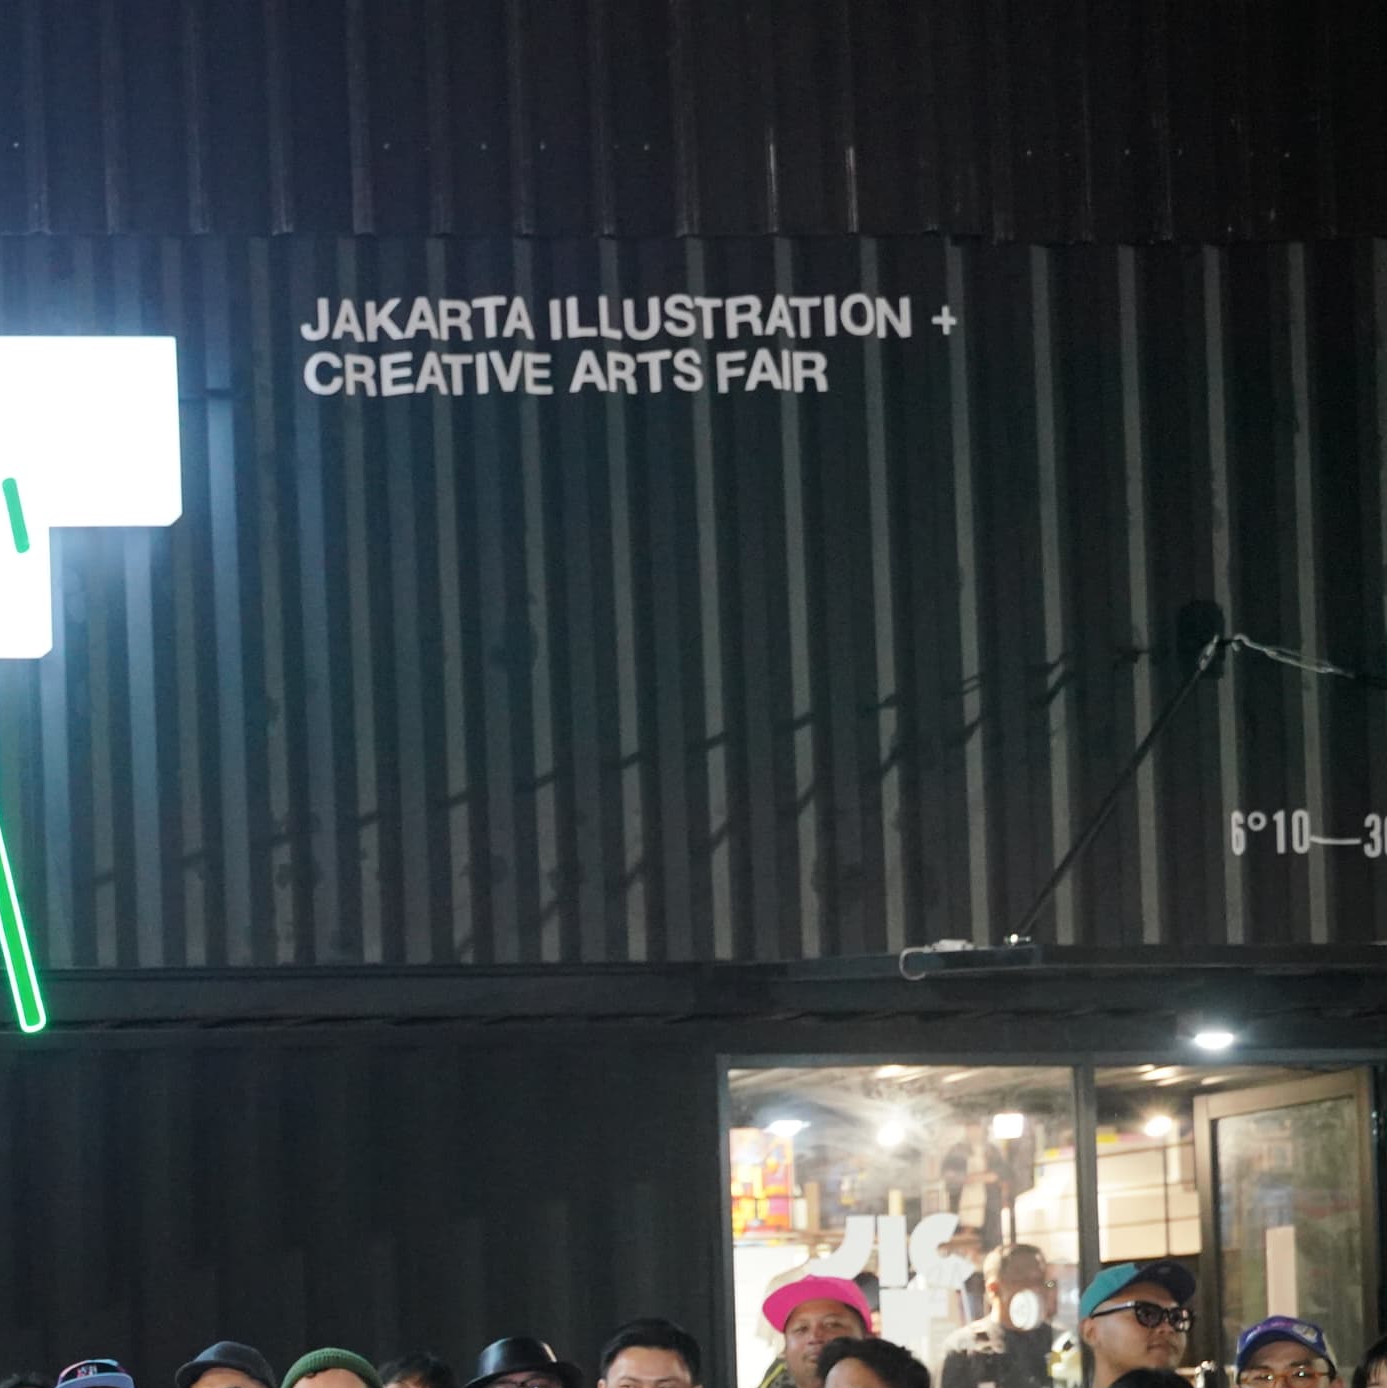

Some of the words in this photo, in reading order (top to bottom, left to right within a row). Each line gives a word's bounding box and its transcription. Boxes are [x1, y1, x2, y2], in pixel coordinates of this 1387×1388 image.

[301, 296, 534, 342] JAKARTA
[550, 293, 912, 340] ILLUSTRATION
[931, 305, 958, 335] +
[303, 350, 553, 397] CREATIVE
[569, 348, 703, 393] ARTS
[717, 349, 828, 393] FAIR
